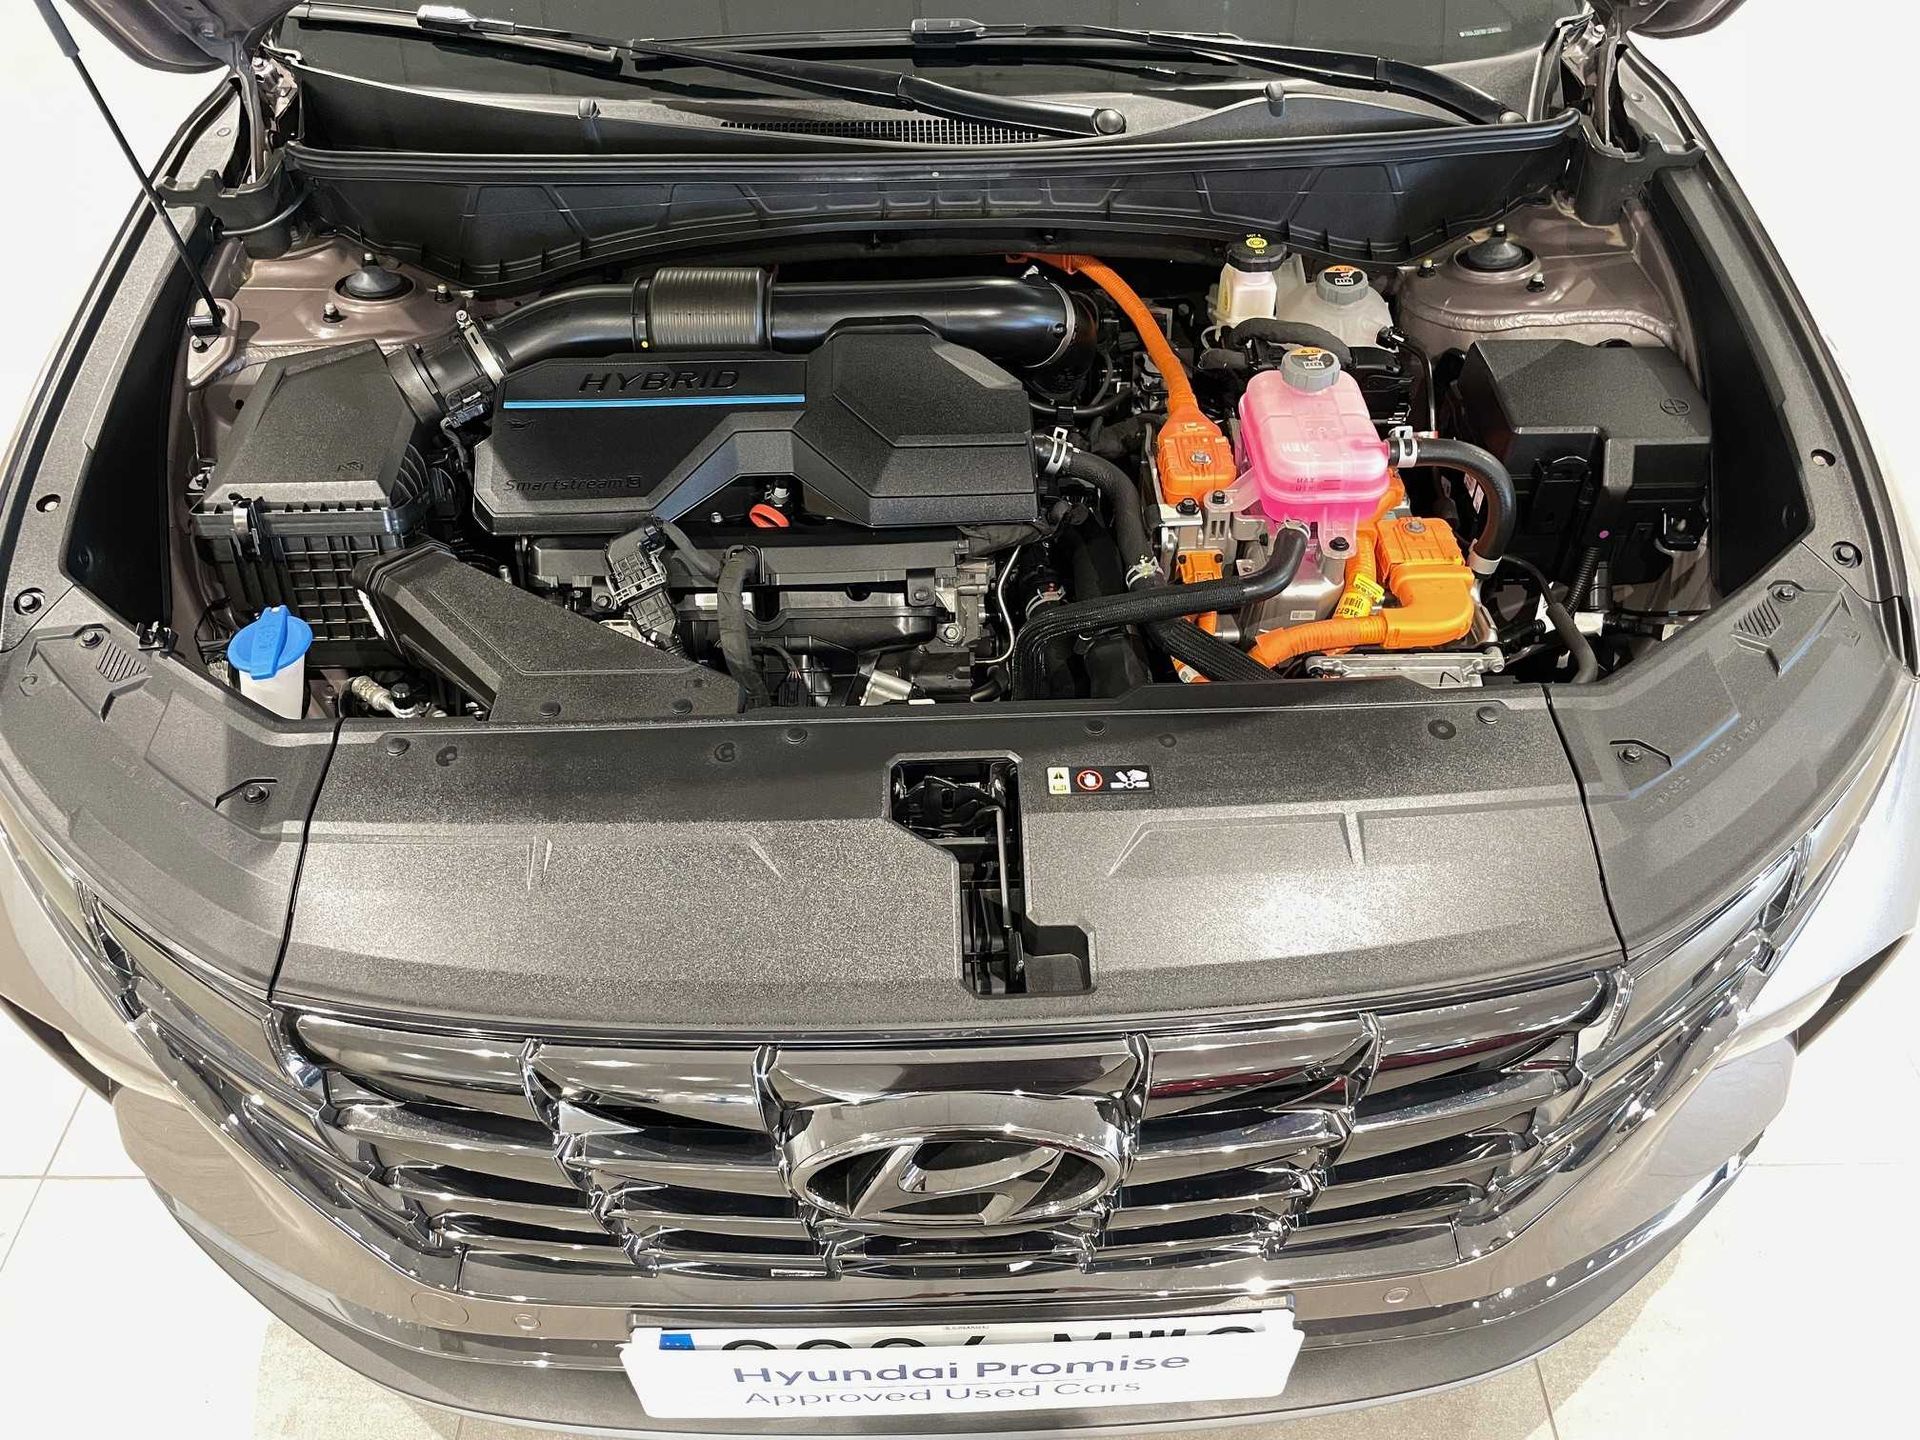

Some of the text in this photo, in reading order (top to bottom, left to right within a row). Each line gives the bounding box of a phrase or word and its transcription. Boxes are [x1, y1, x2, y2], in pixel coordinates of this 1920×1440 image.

[578, 370, 741, 393] HYBRID
[504, 478, 623, 492] Smartstream
[733, 1355, 1190, 1386] Hyundai Promise
[745, 1381, 1141, 1406] Approved Used Cars
